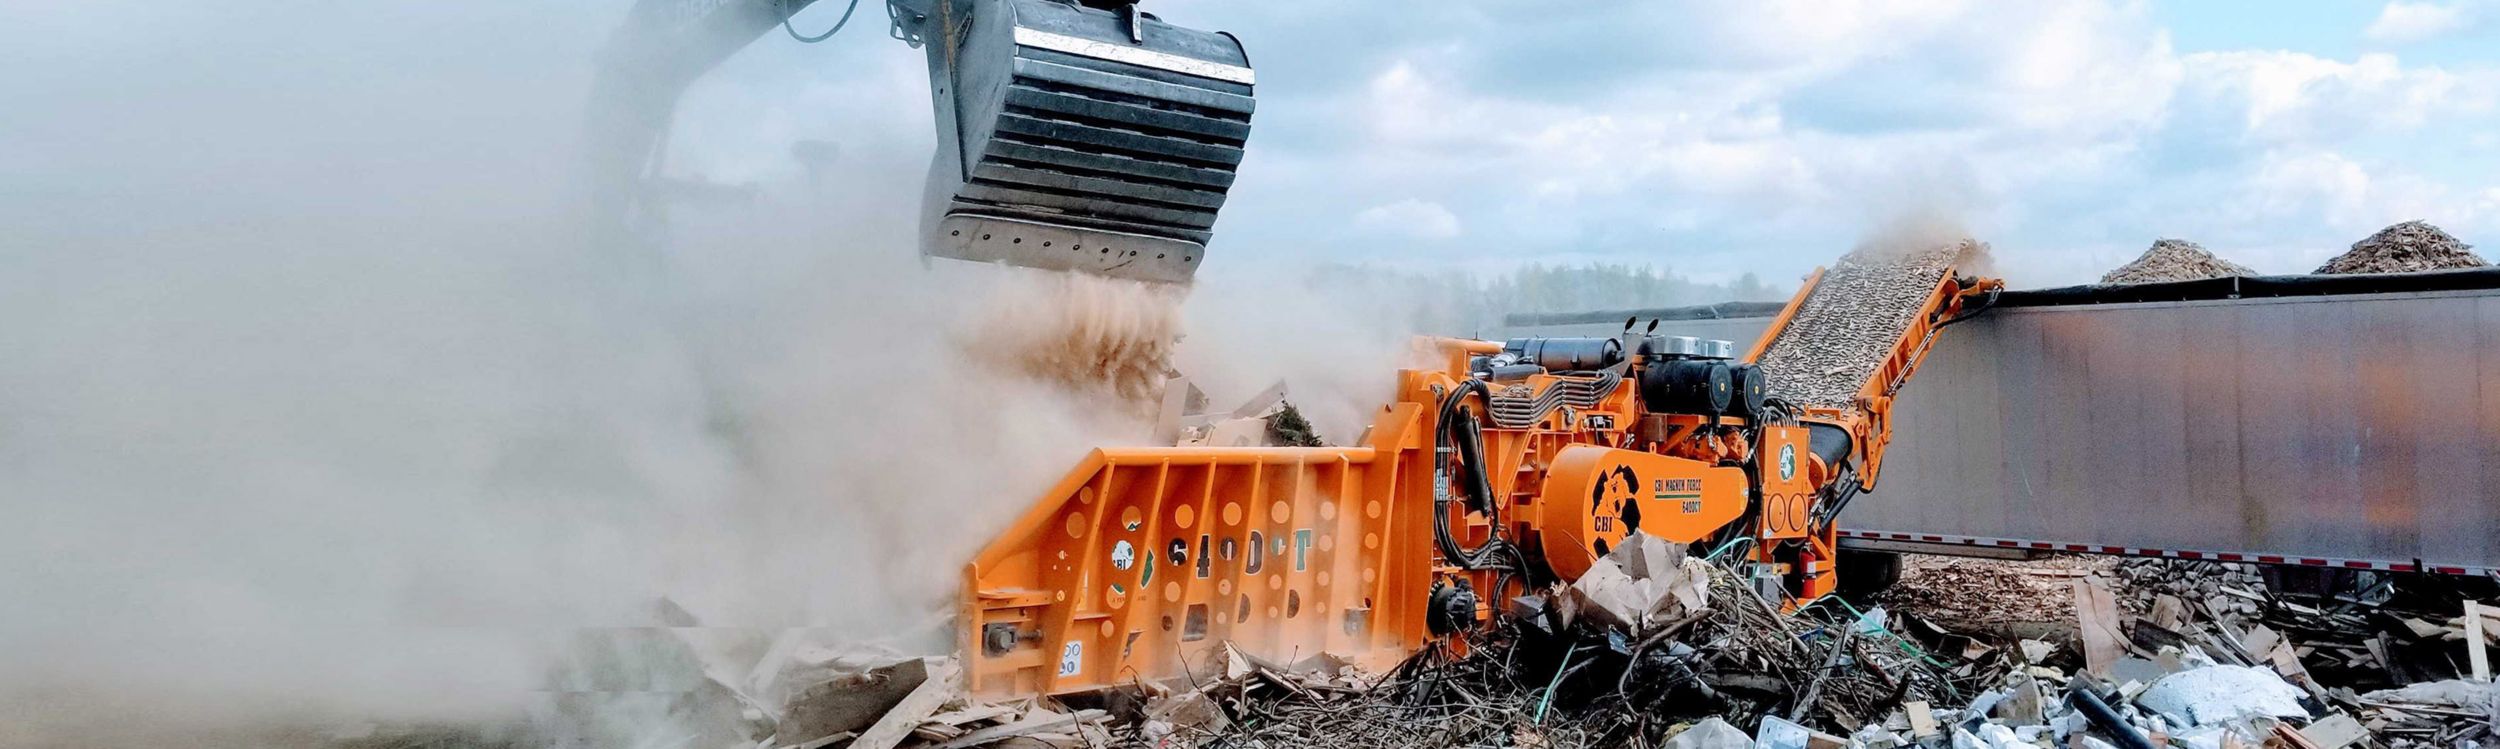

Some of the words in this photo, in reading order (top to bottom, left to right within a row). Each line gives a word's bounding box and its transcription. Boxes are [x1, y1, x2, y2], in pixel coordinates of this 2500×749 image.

[1654, 478, 1664, 492] CBI
[1665, 478, 1685, 492] MAGNUM
[1686, 478, 1702, 491] FORCE
[1594, 516, 1613, 532] CBI
